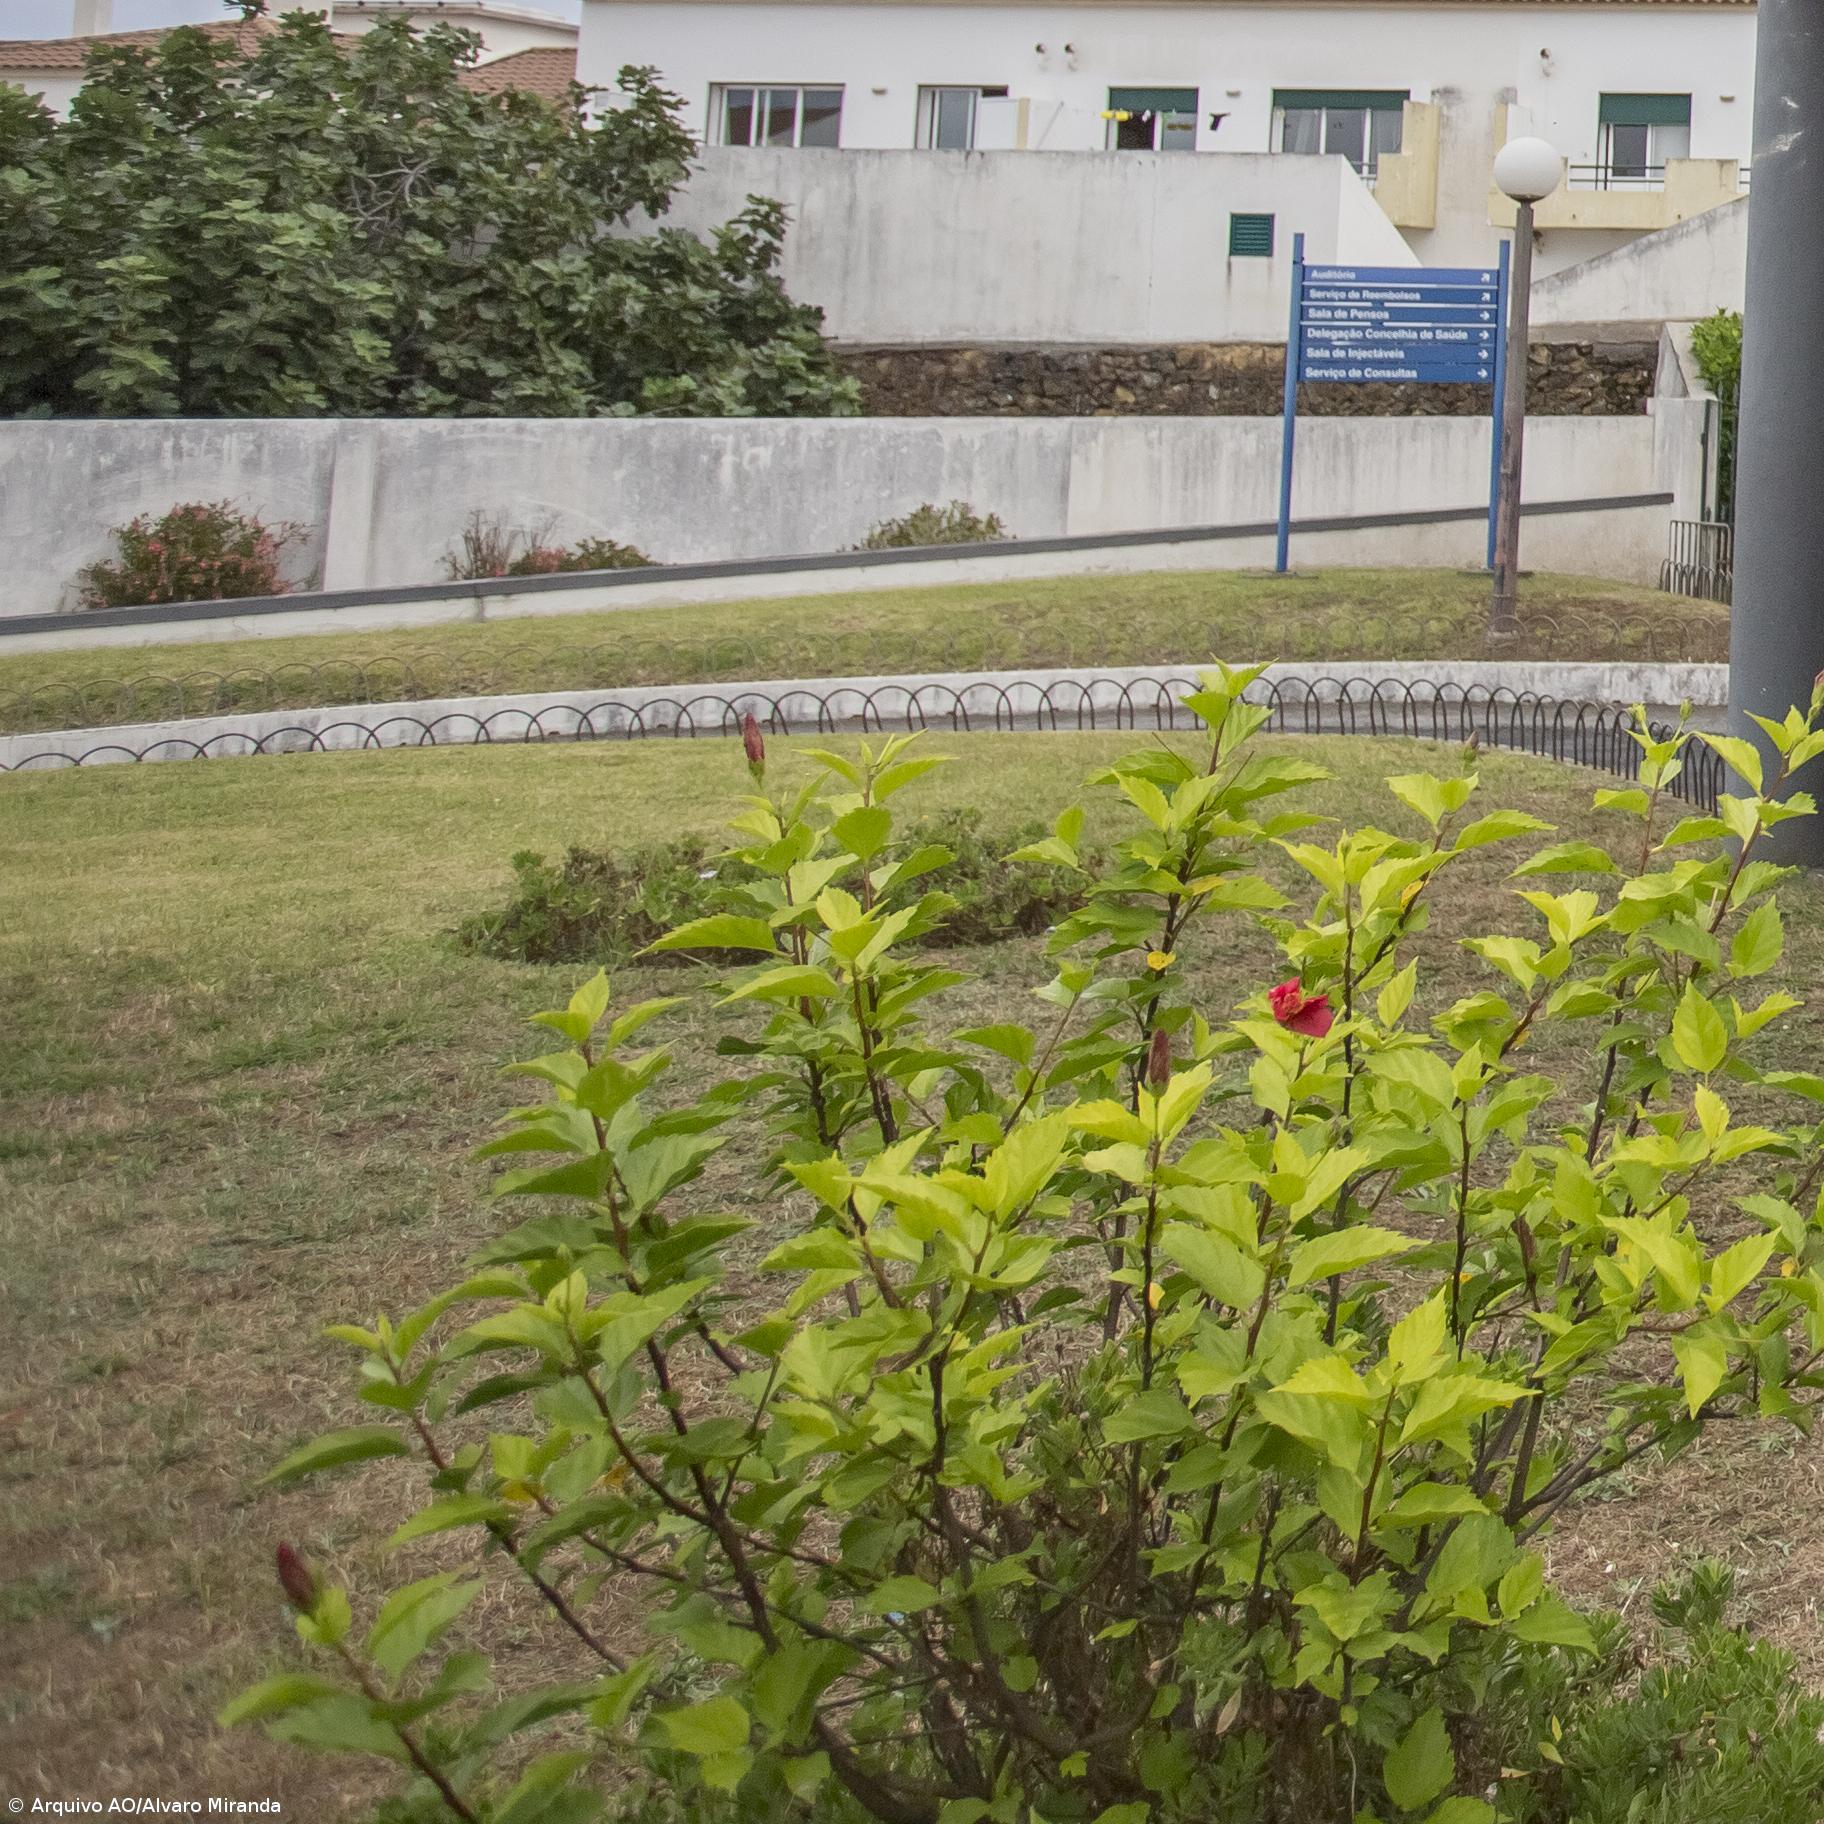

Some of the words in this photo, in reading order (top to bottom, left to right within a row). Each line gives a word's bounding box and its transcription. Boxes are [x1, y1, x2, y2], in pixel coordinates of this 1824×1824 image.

[1311, 269, 1356, 280] Auditório
[1309, 288, 1347, 301] Serviço
[1347, 290, 1361, 300] de
[1308, 308, 1333, 319] Sala
[1334, 308, 1349, 319] de
[1350, 308, 1390, 320] Pensos
[1307, 327, 1363, 340] Delegação
[1365, 328, 1418, 339] Concelhia
[1420, 329, 1434, 339] de
[1435, 329, 1468, 340] Saúde
[1306, 347, 1331, 358] Sala
[1332, 348, 1347, 358] de
[1348, 348, 1405, 360] Injectáveis
[1305, 366, 1347, 379] Serviço
[1348, 367, 1362, 378] de
[1364, 367, 1418, 378] Consultas
